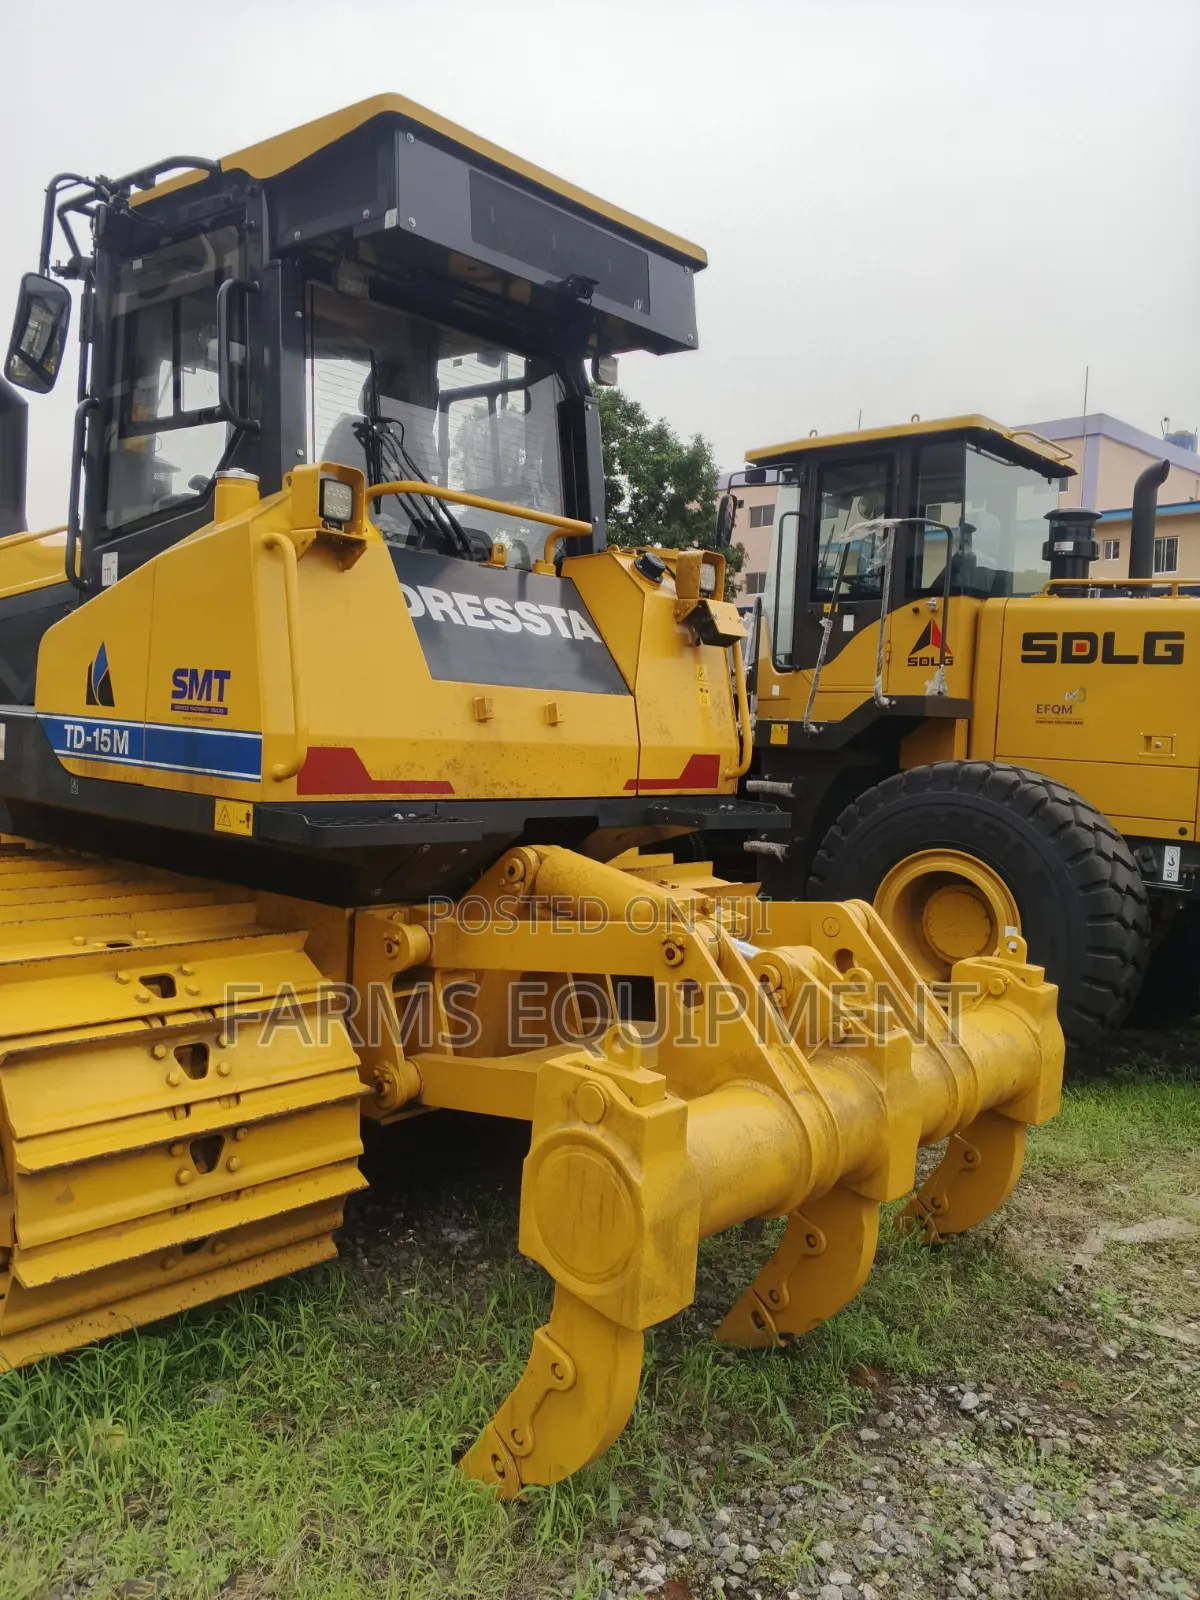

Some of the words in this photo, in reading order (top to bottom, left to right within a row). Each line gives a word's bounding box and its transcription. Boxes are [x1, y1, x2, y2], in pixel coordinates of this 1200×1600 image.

[907, 656, 954, 667] SDLG
[1021, 631, 1186, 665] SDLG
[171, 667, 231, 702] SMT
[1036, 703, 1073, 715] EFQM
[64, 724, 129, 755] TD-15M
